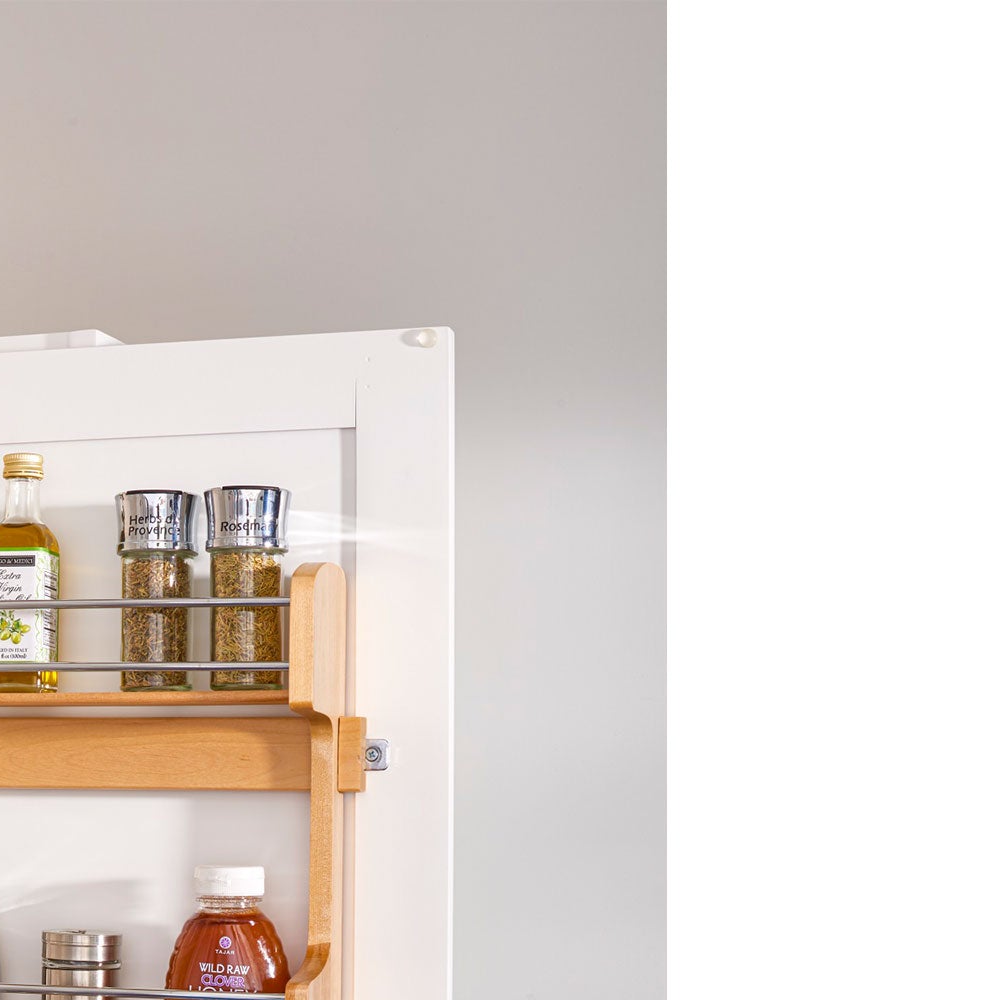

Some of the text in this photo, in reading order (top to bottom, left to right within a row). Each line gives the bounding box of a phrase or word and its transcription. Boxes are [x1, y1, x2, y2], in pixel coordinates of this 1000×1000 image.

[129, 513, 162, 526] Herbs
[128, 526, 180, 536] Provence
[220, 521, 278, 534] Rosemay
[199, 962, 250, 976] WILD RAW
[200, 974, 246, 988] CLOVER
